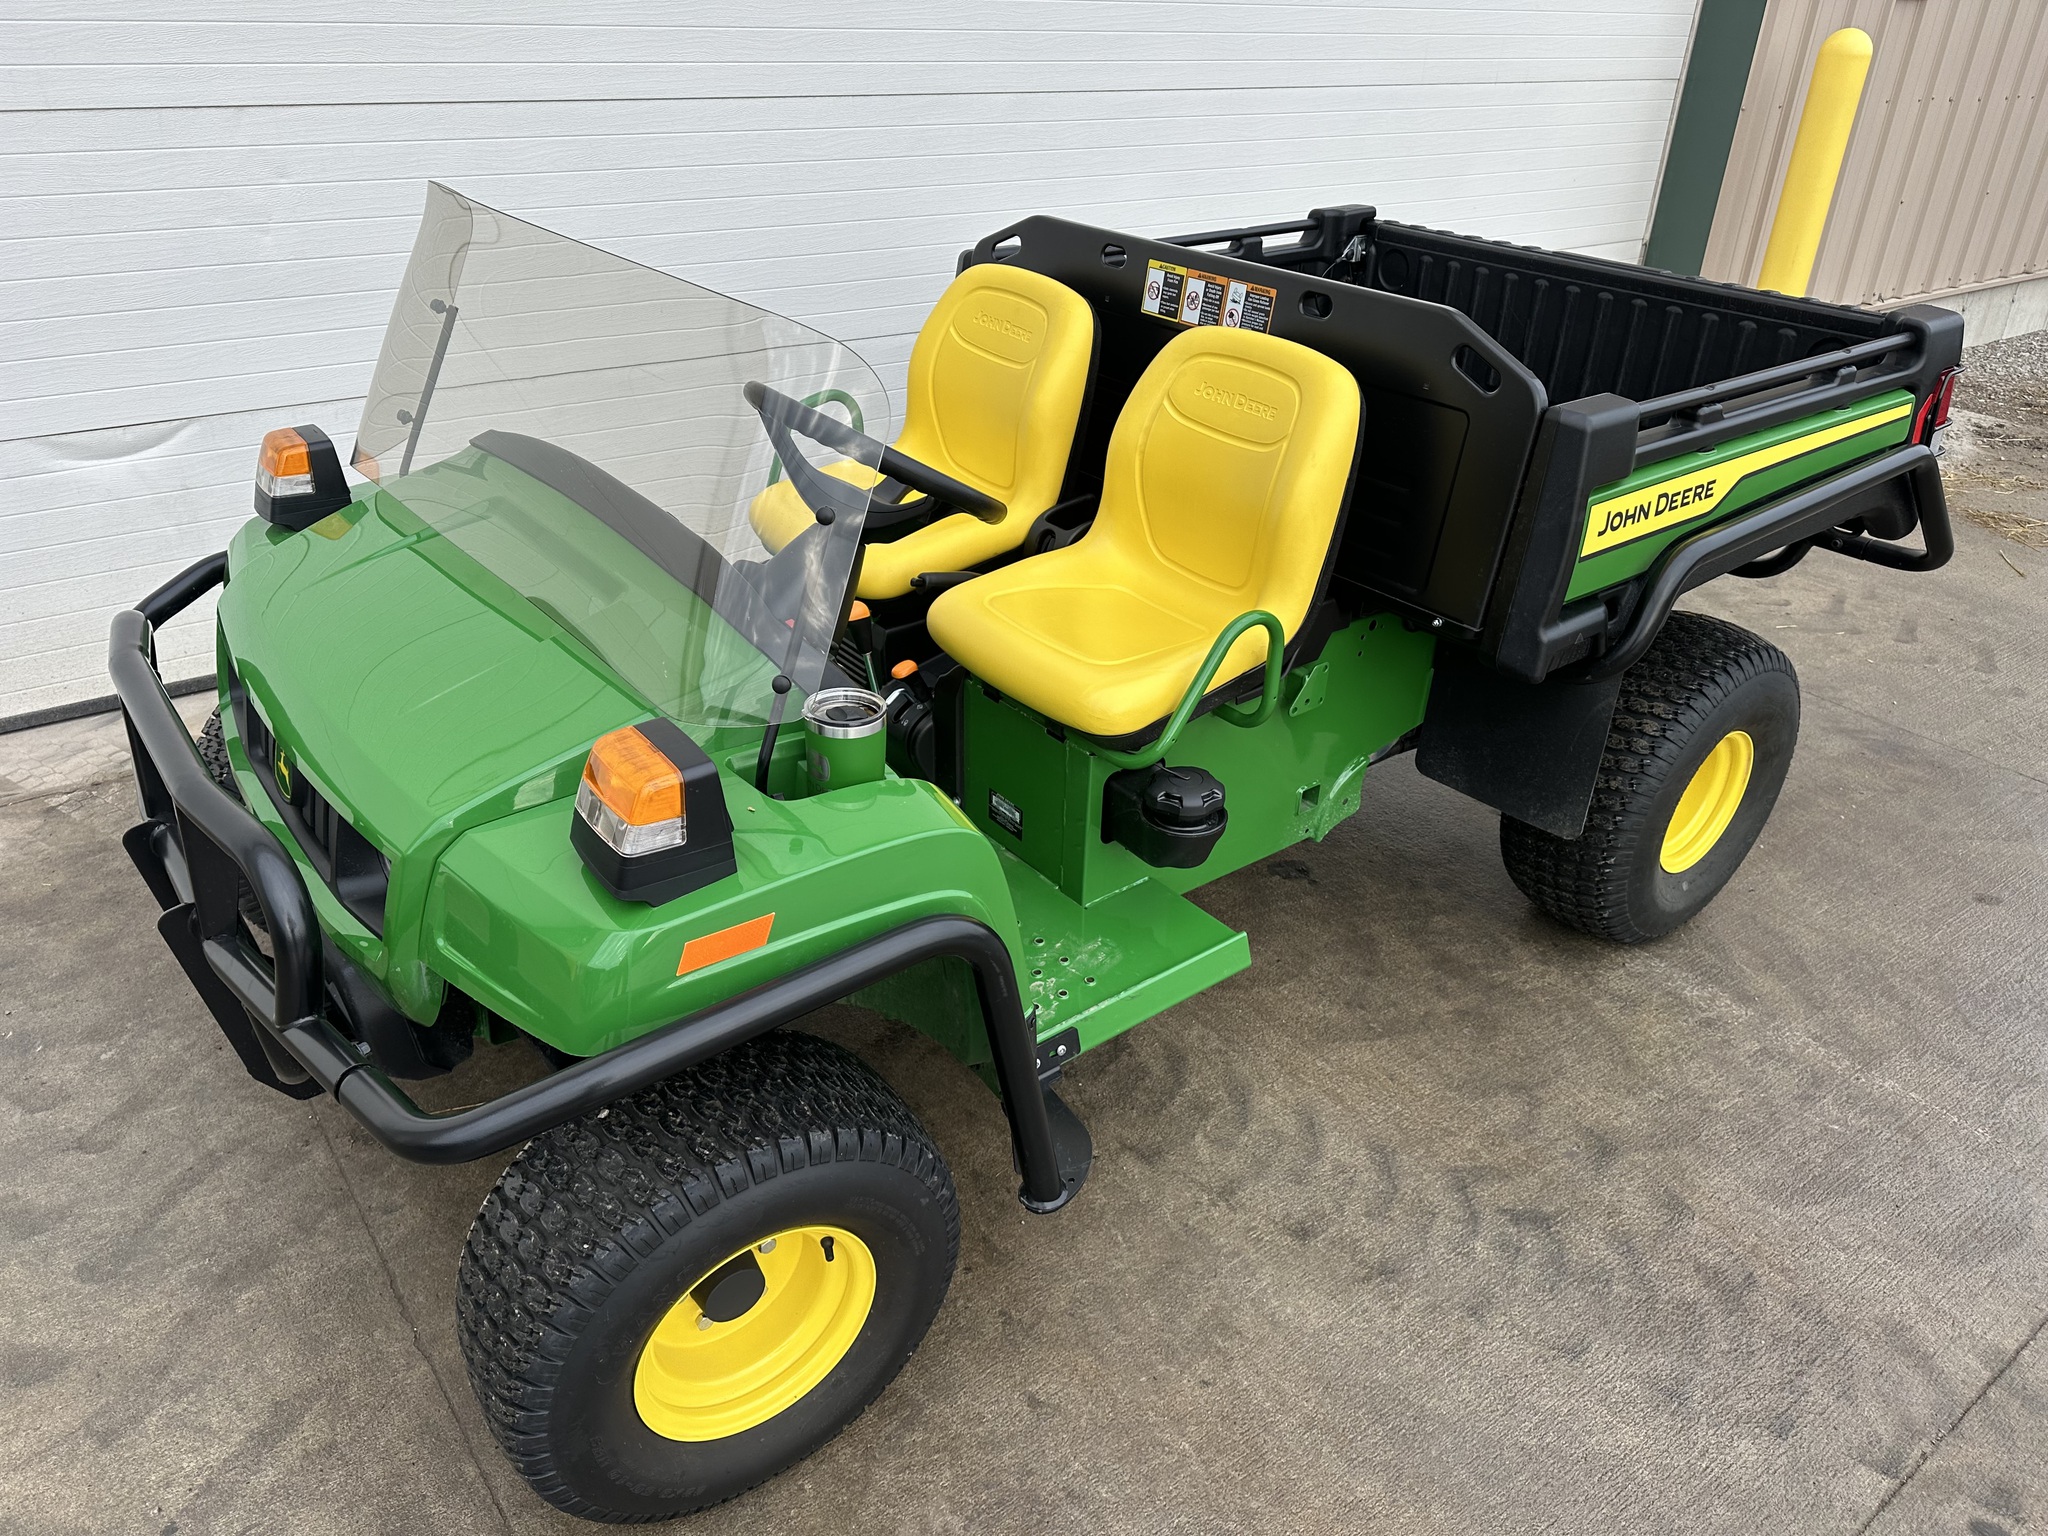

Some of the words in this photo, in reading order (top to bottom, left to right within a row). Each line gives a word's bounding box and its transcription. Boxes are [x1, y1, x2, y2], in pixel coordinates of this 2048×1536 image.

[973, 309, 1003, 331] JOHN
[1002, 320, 1032, 343] DEERE
[1194, 381, 1235, 406] JOHN
[1234, 393, 1278, 421] DEERE
[1597, 501, 1652, 537] JOHN
[1654, 479, 1717, 517] DEERE
